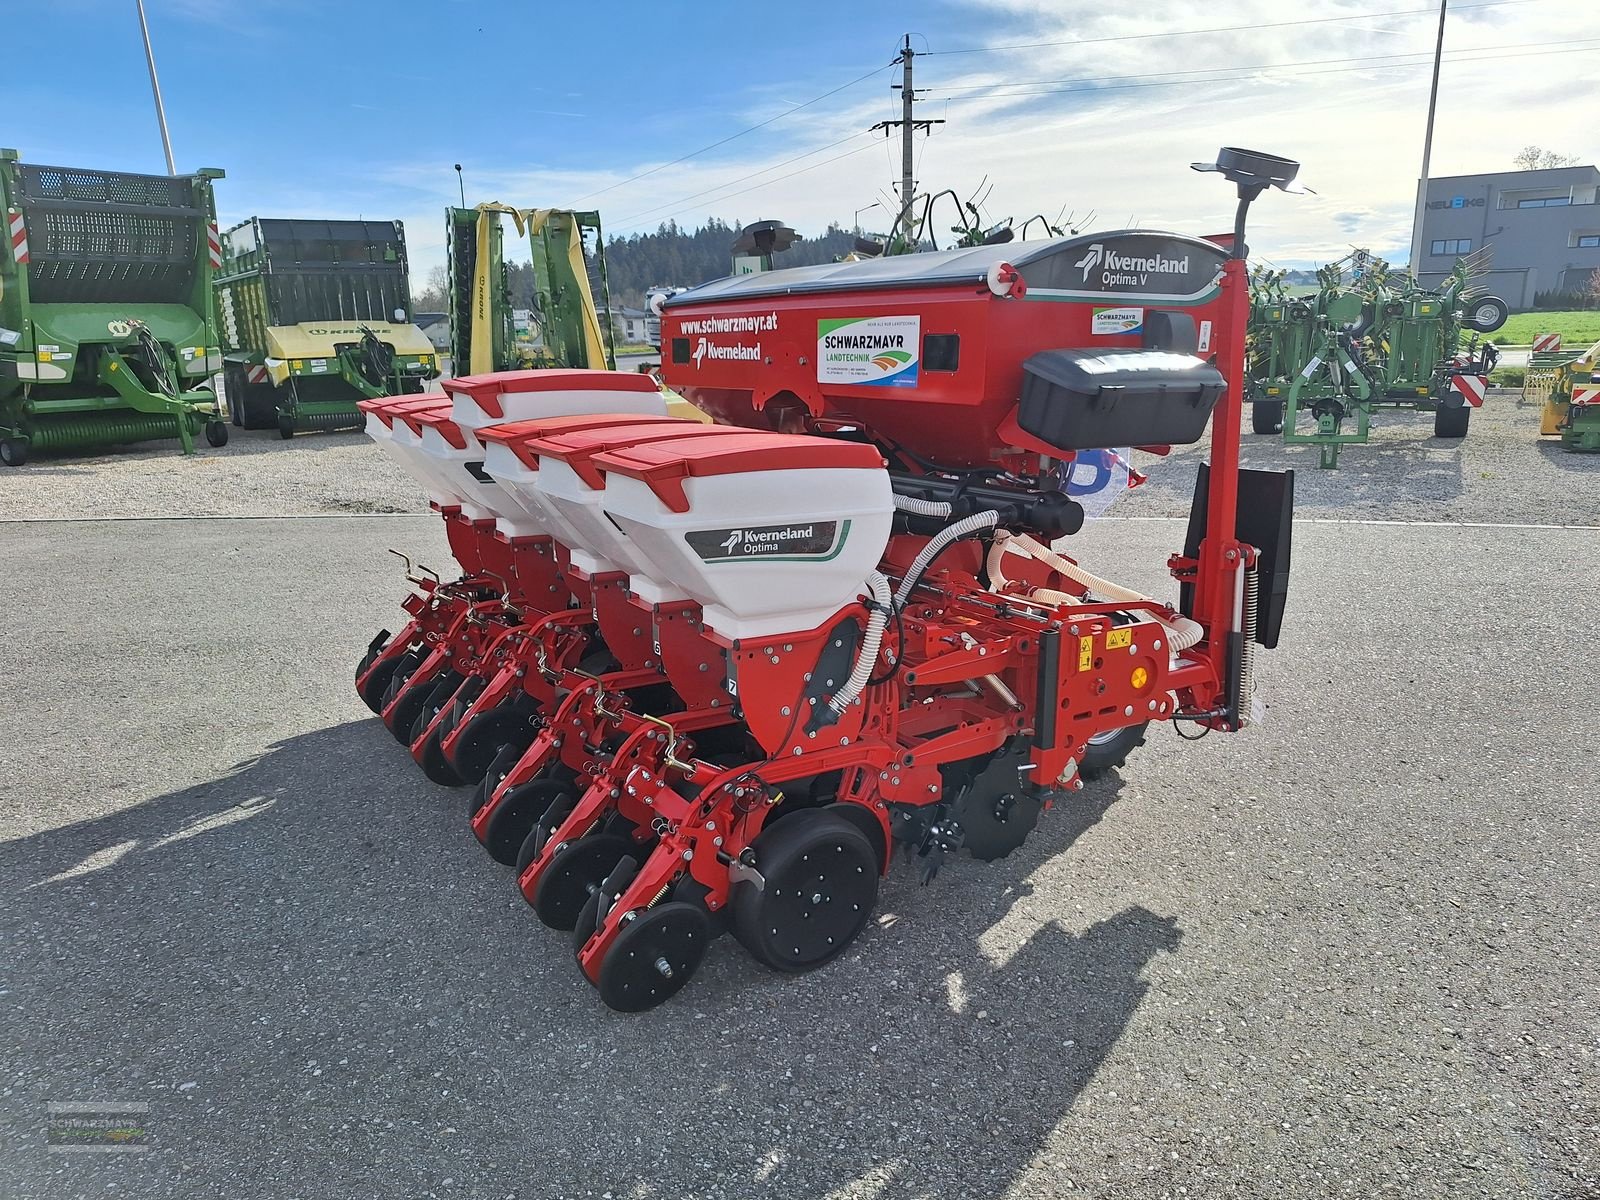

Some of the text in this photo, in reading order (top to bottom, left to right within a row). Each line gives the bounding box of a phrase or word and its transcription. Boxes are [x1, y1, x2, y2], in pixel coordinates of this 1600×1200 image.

[1104, 250, 1189, 274] Kverneland
[1102, 272, 1148, 287] Optima V
[680, 311, 778, 335] www.schwarzmayr.at
[825, 334, 904, 349] SCHWARZMAYR
[708, 341, 761, 360] Kverneland
[826, 353, 870, 362] LANDTECHNIK
[744, 525, 813, 543] Kverneland
[743, 543, 778, 555] Optima
[729, 680, 736, 692] 7
